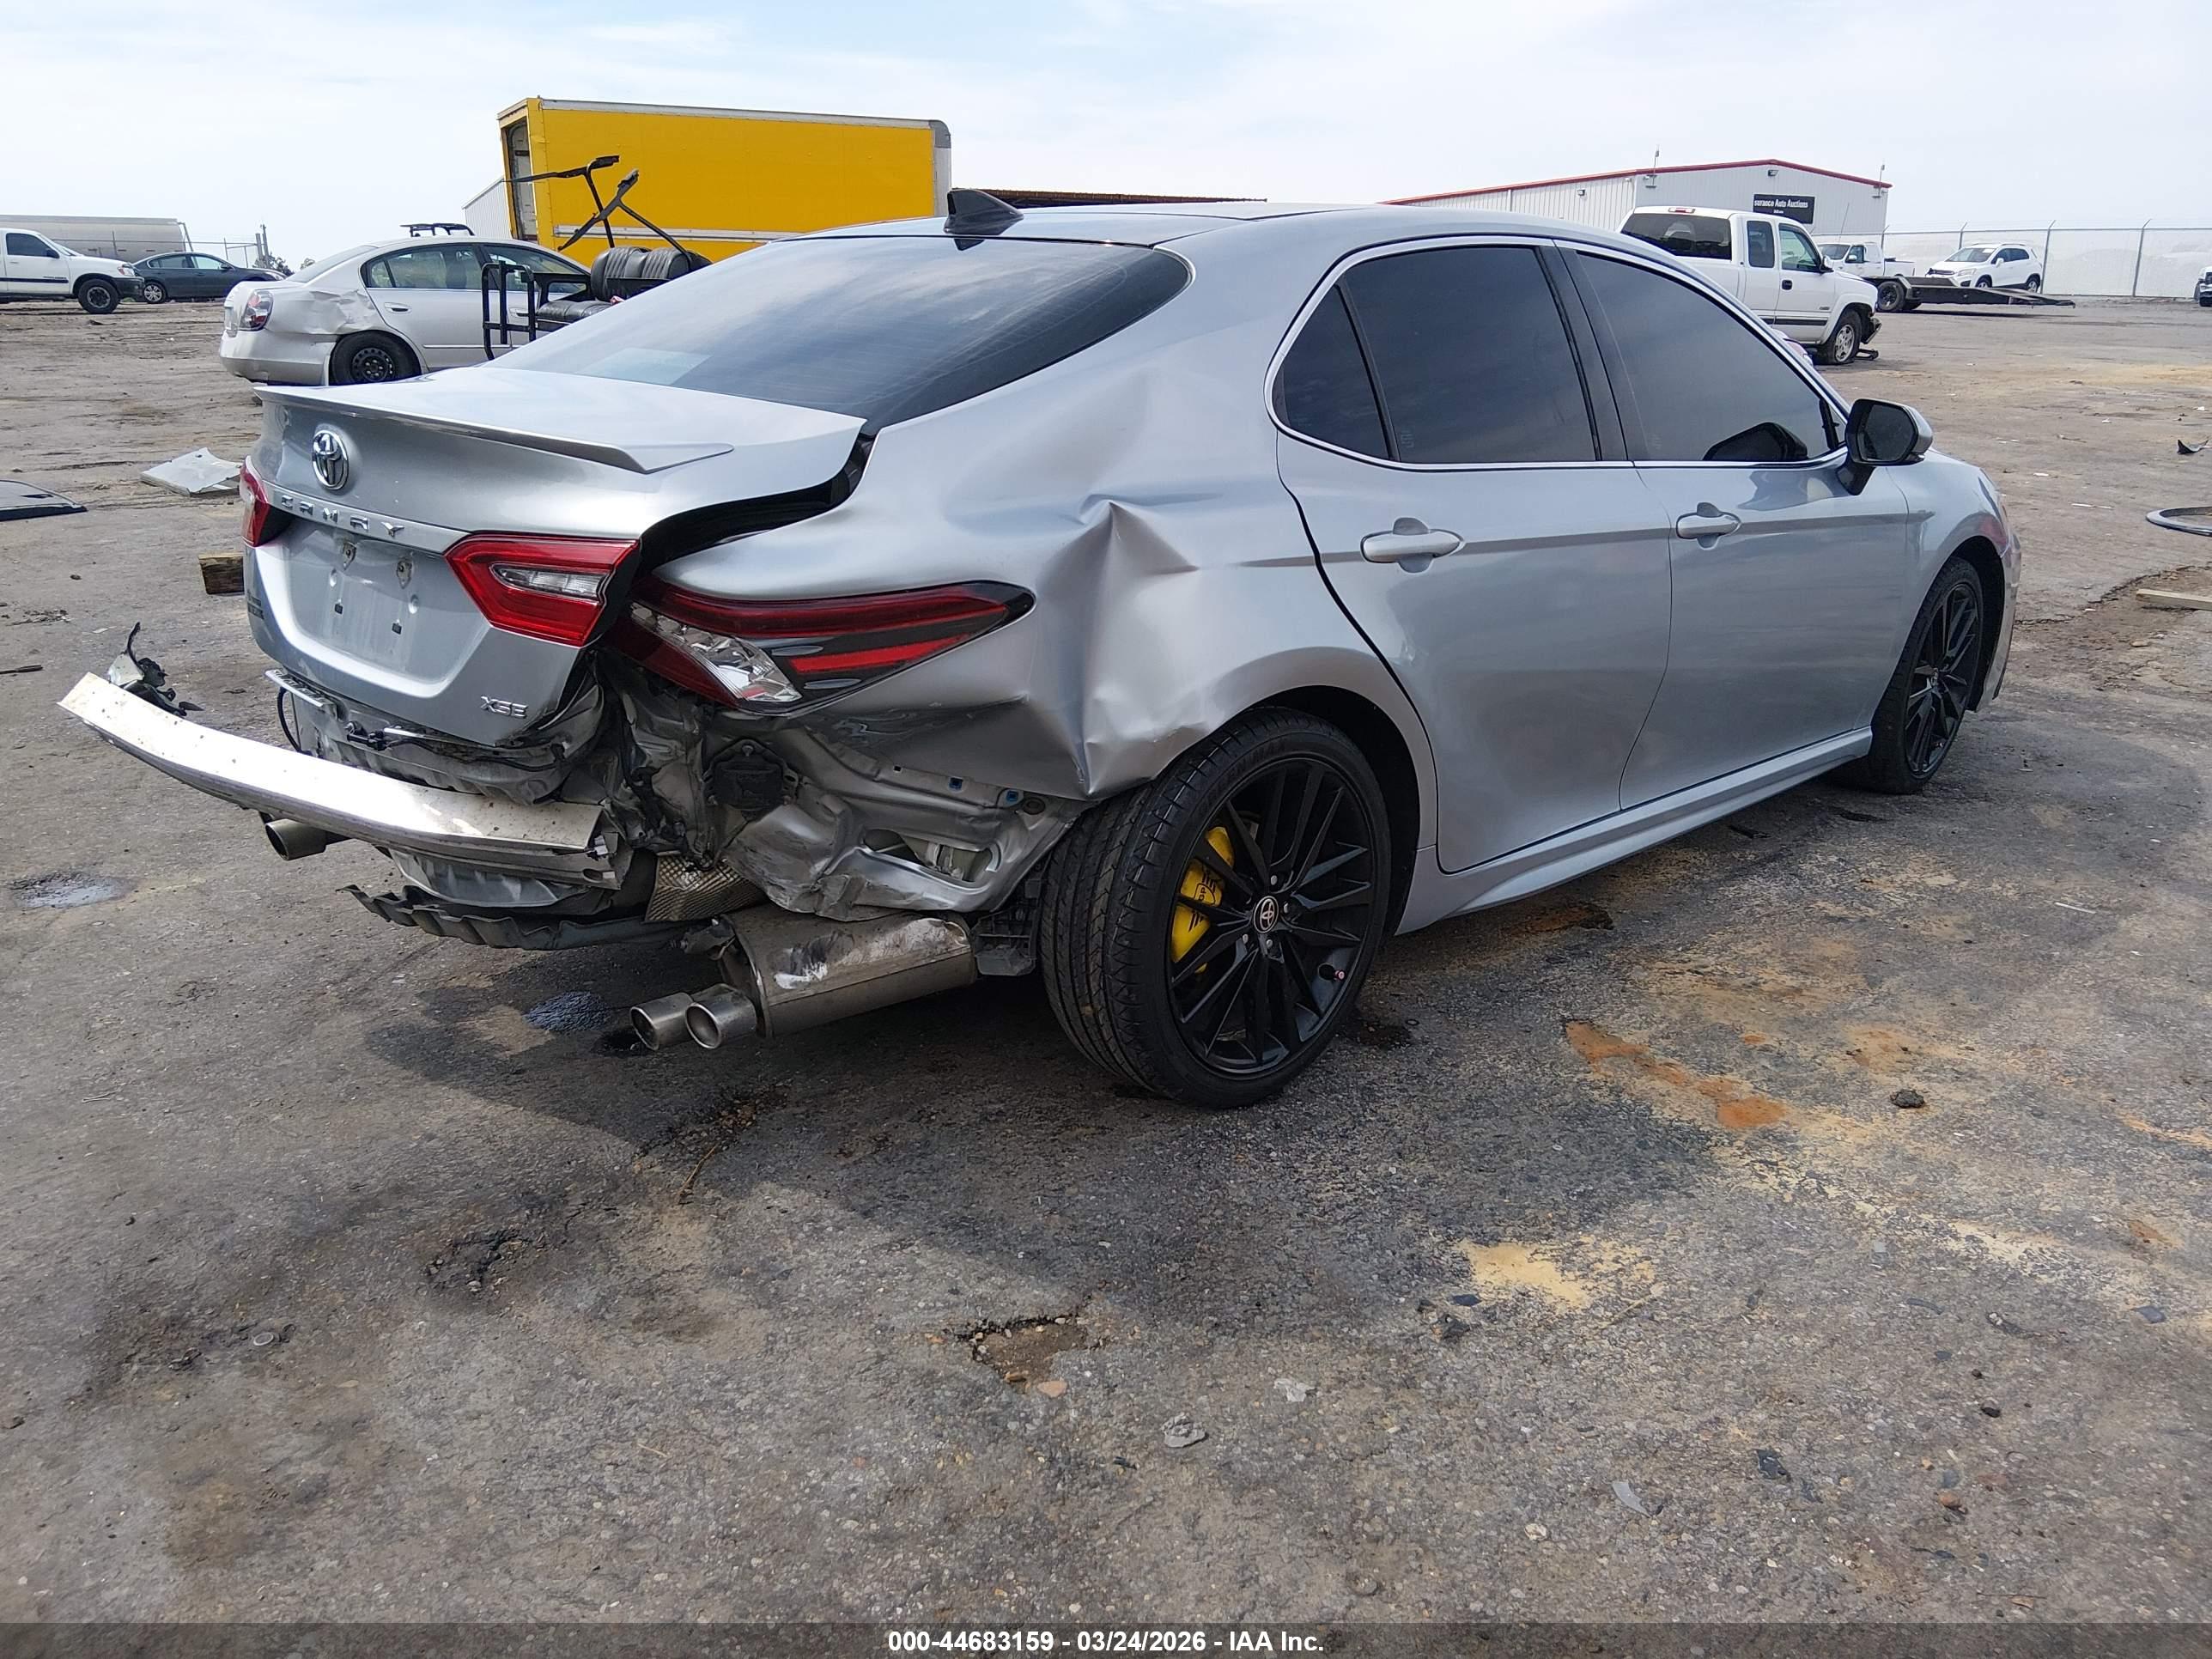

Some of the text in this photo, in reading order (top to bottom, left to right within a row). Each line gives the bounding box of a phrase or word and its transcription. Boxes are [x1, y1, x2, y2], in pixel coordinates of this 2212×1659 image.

[1775, 198, 1786, 207] Auto
[1787, 198, 1808, 208] Auctions
[281, 495, 404, 537] CAMRY
[481, 696, 528, 718] XSE
